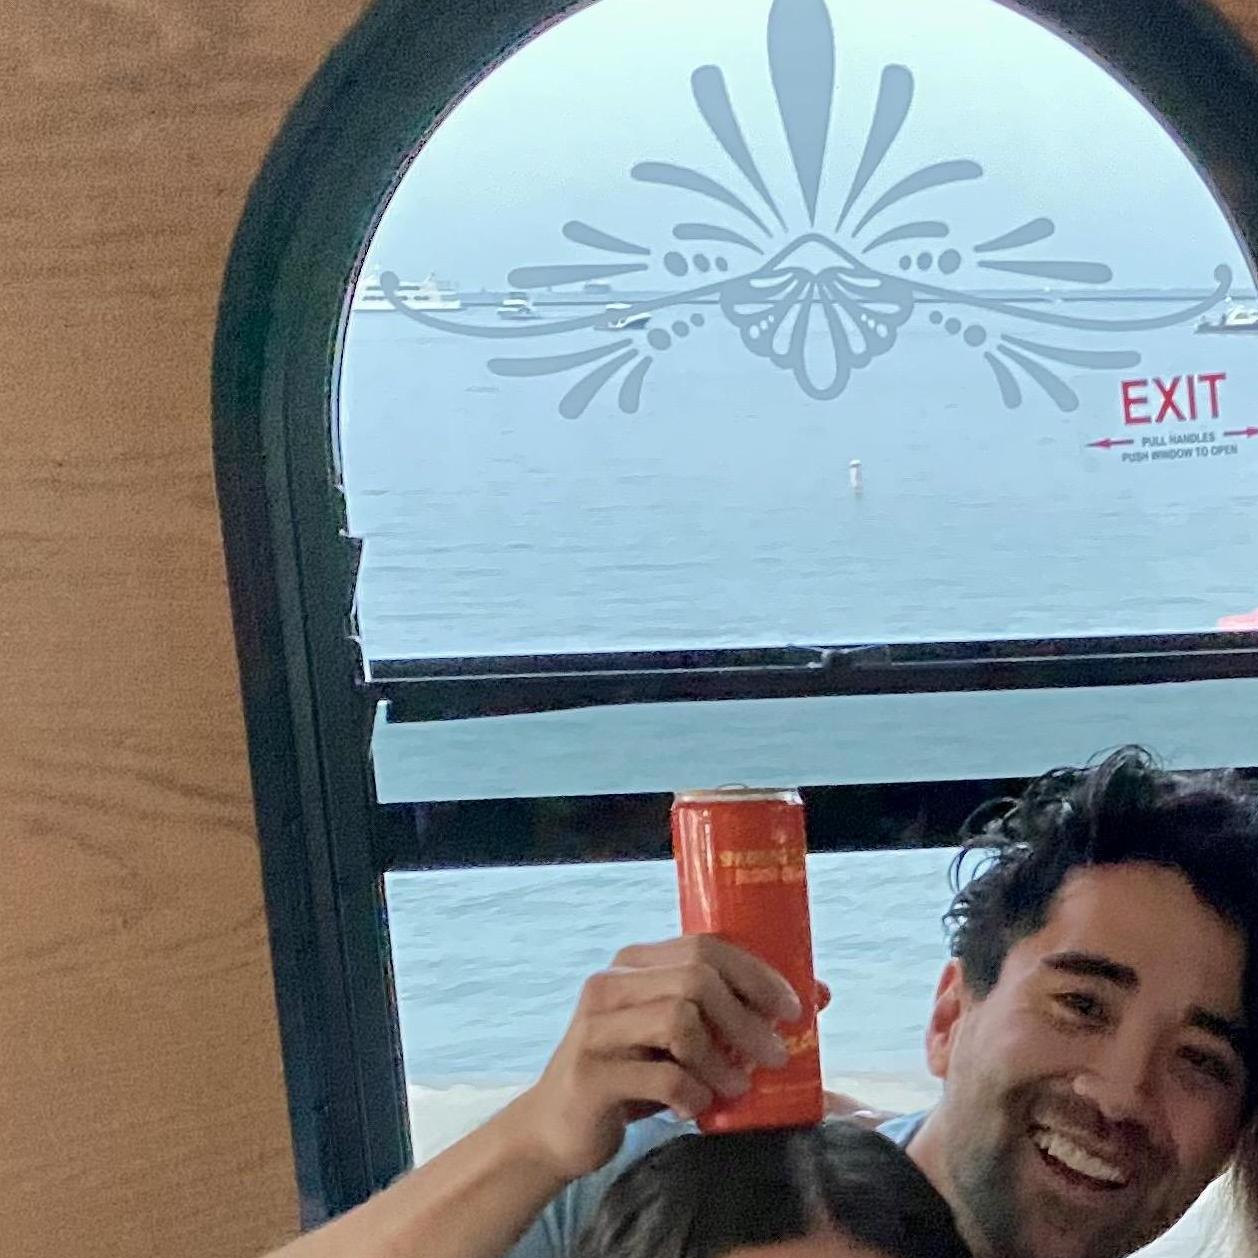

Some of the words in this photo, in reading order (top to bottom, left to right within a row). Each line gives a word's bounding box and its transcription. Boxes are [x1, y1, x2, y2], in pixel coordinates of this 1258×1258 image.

[1121, 372, 1226, 425] EXIT
[1142, 436, 1167, 447] PULL
[1169, 432, 1215, 444] HANDLES
[1122, 451, 1149, 462] PUSH
[1151, 448, 1193, 460] WINDOW
[1195, 447, 1208, 457] TO
[1211, 444, 1238, 456] OPEN
